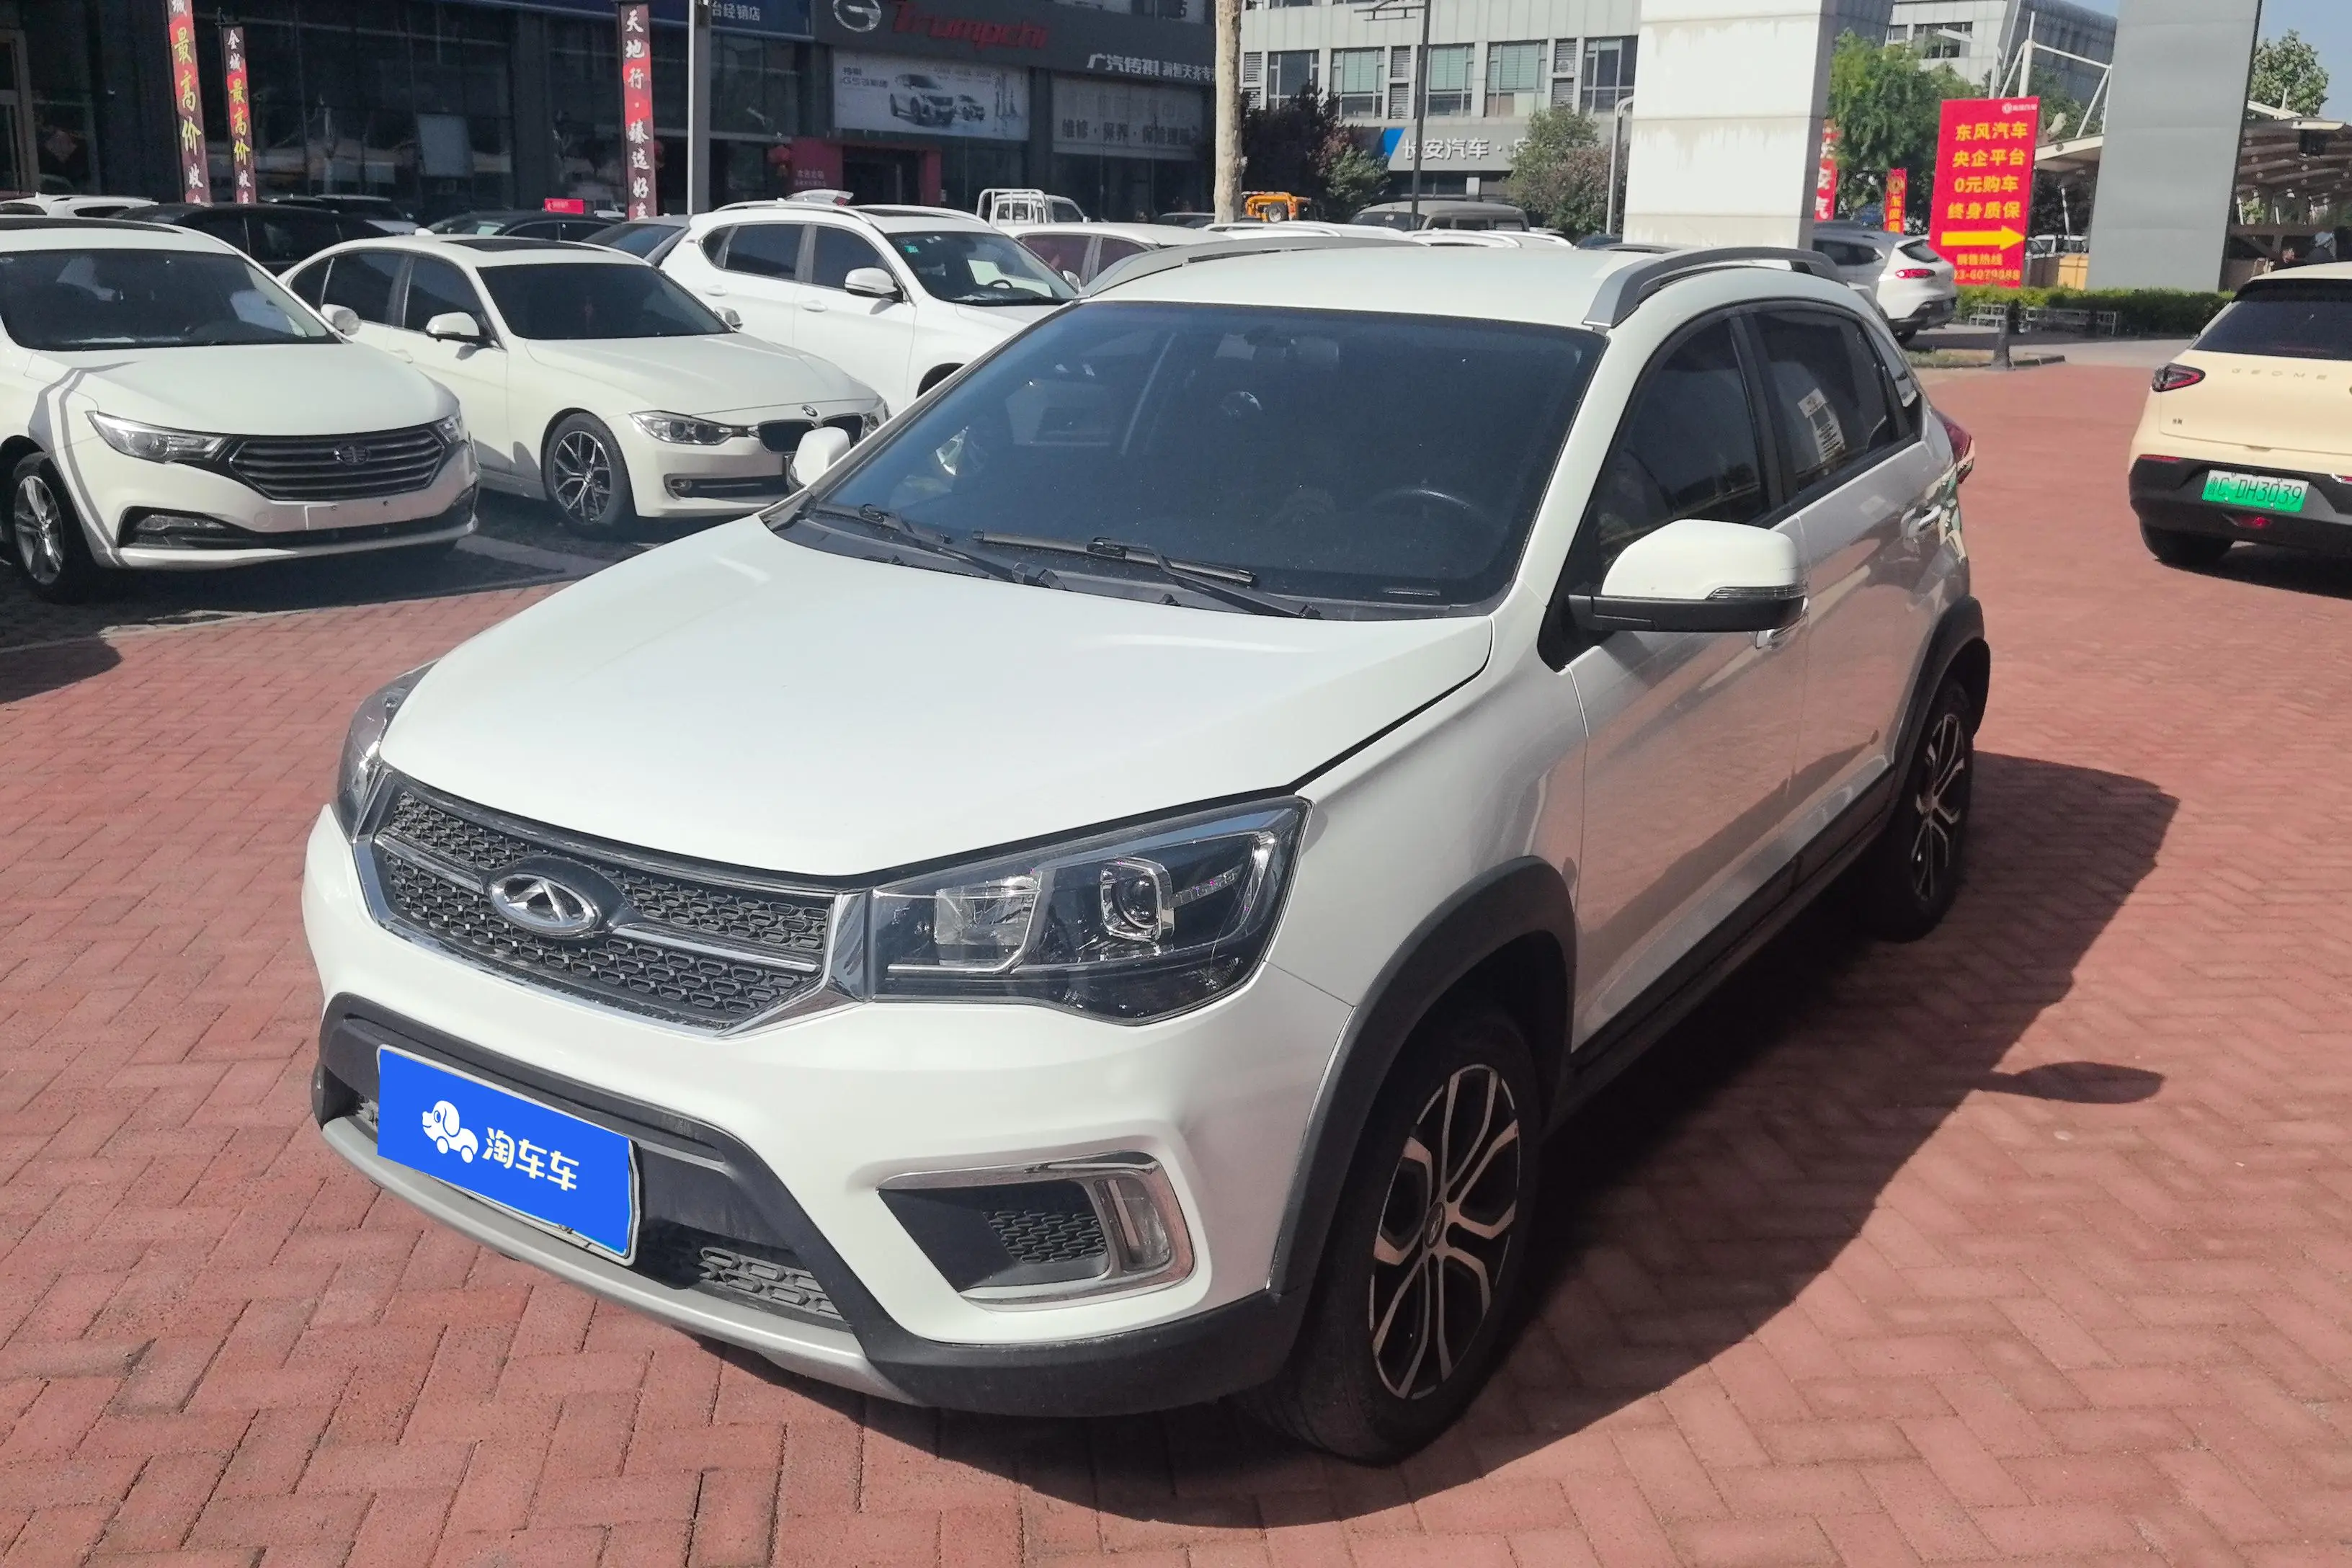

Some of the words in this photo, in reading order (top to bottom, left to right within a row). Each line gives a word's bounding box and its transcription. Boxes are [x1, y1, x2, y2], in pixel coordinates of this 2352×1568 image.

[891, 1, 1048, 50] Trumpchi
[1087, 53, 1159, 76] 广汽传祺
[1955, 121, 2028, 141] 东风汽车
[1952, 148, 2026, 168] 央企平台
[1954, 174, 2019, 193] 0元购车
[1947, 201, 2021, 219] 终身质保
